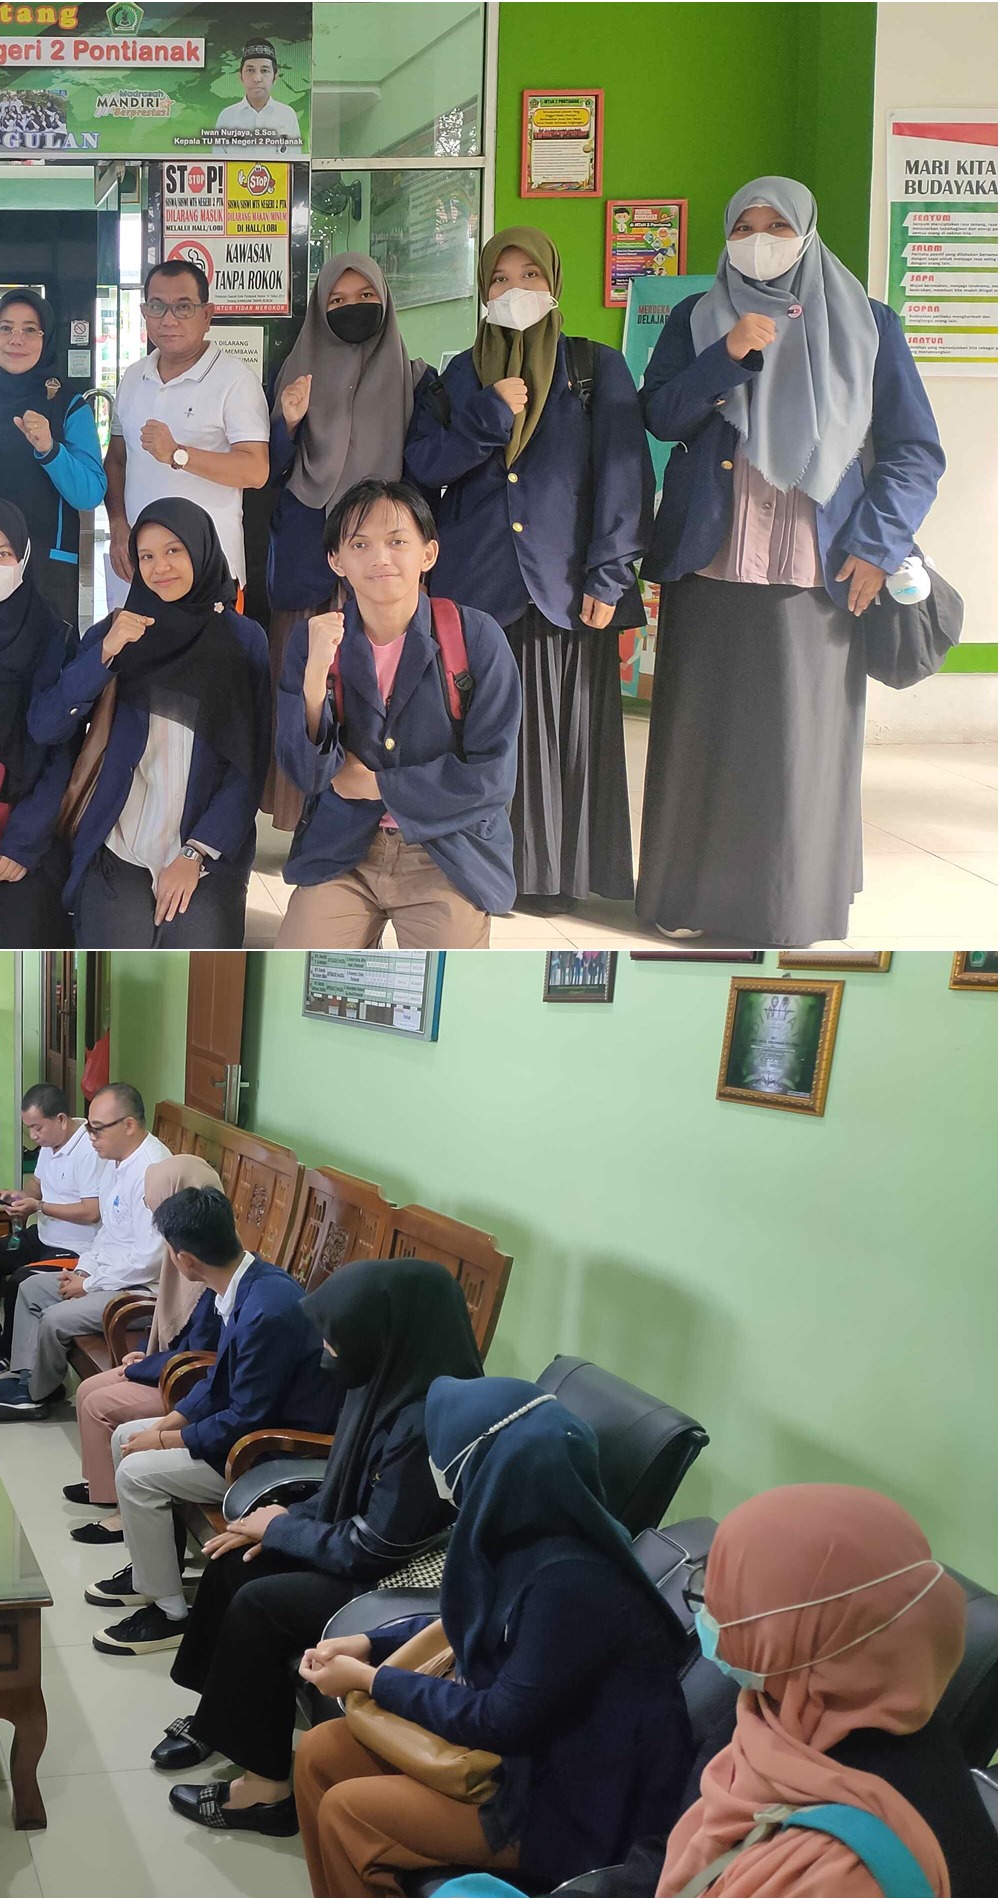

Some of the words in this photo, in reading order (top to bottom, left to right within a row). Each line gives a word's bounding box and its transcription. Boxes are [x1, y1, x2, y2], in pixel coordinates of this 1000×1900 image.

[50, 40, 65, 60] 2
[73, 40, 201, 62] Pontianak
[119, 90, 164, 98] Madrasah
[97, 98, 159, 108] MANDIRI
[221, 129, 253, 137] Nurjaya,
[174, 138, 200, 146] Kepala
[231, 138, 257, 147] Negeri
[905, 160, 949, 174] MARI
[957, 160, 996, 175] KITA
[188, 174, 205, 184] STOP
[166, 209, 198, 222] DILARANG
[200, 209, 223, 222] MASUK
[227, 212, 251, 221] DILARANG
[237, 224, 244, 232] DI
[245, 224, 278, 233] HALL/LOBI
[226, 243, 272, 263] KAWASAN
[215, 270, 245, 290] TANPA
[247, 270, 283, 290] ROKOK
[638, 304, 670, 314] MERDEKA
